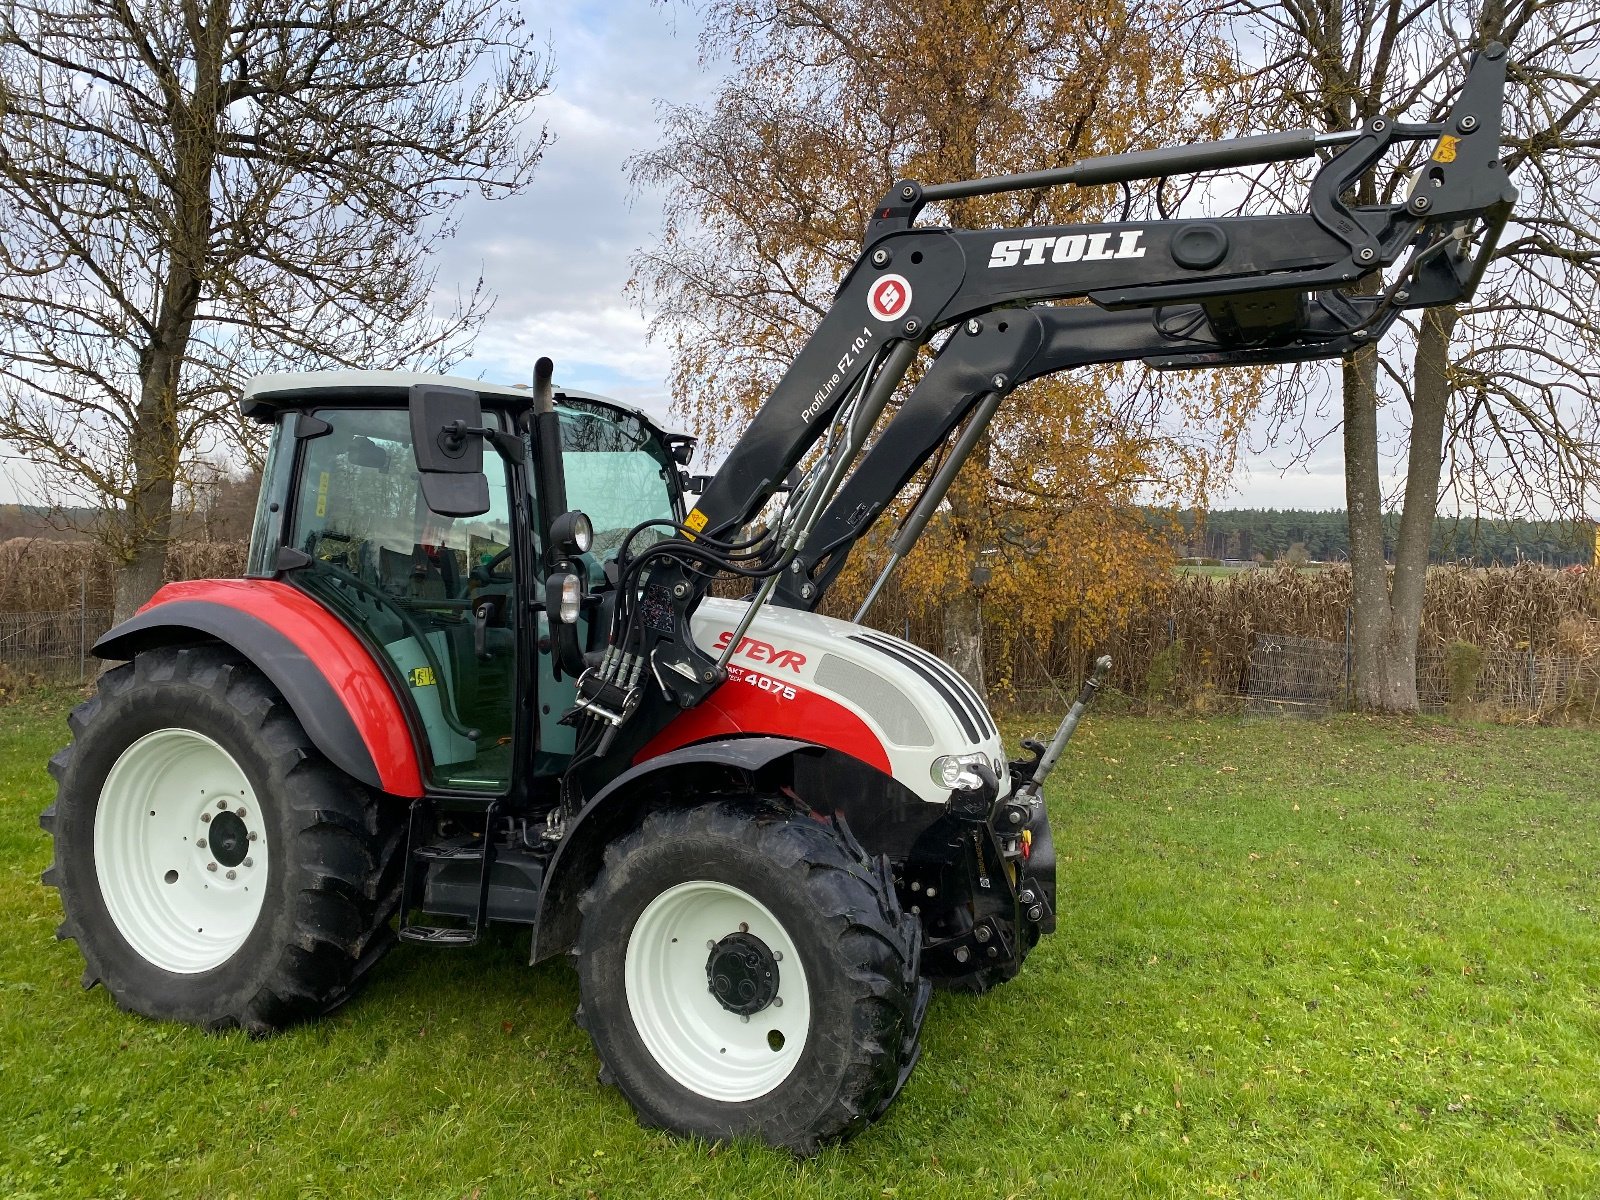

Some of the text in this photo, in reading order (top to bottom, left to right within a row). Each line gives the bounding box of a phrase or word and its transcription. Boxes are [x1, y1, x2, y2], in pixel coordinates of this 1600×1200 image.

[988, 230, 1147, 268] STOLL
[801, 326, 873, 424] ProfiLine FZ 10.1
[712, 631, 807, 674] STEYR
[744, 674, 797, 701] 4075
